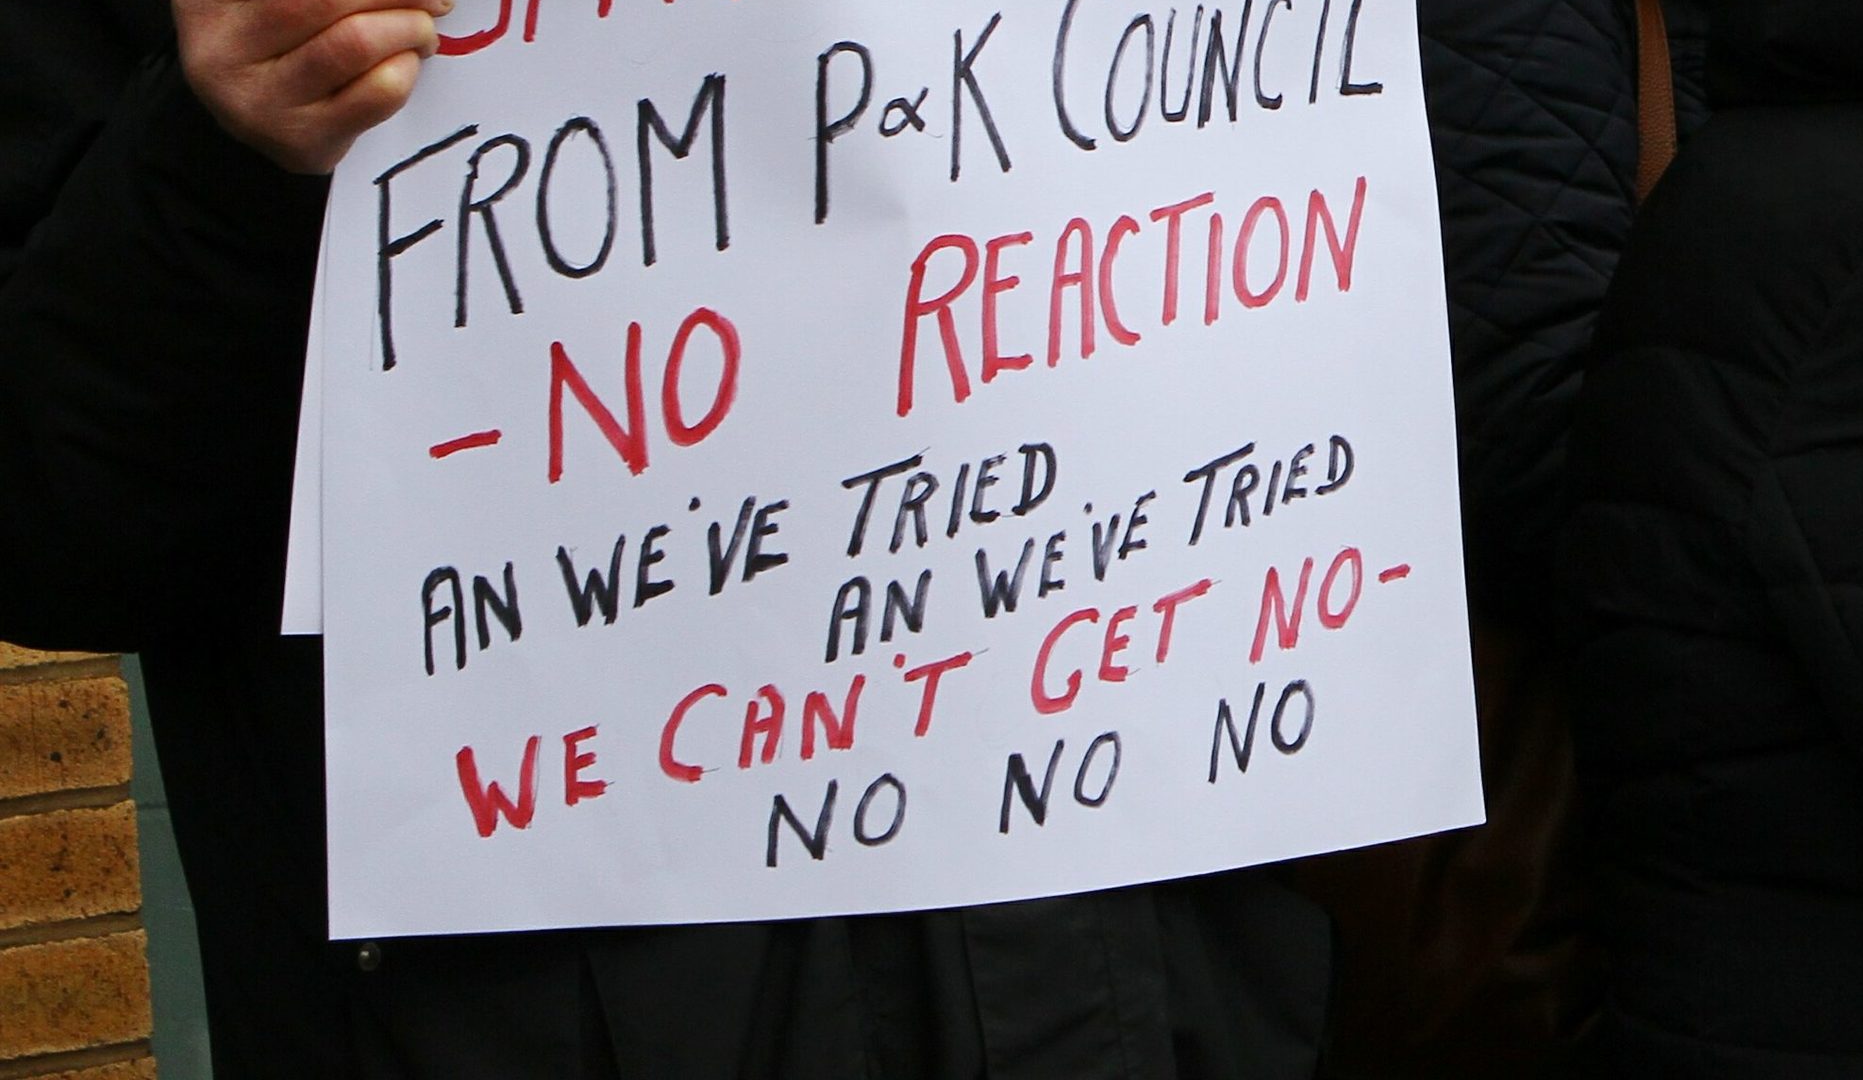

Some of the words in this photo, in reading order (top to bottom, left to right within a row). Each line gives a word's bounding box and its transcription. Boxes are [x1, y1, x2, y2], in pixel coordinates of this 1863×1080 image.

[371, 71, 731, 372] FROM
[547, 307, 742, 485] NO
[896, 175, 1368, 418] REACTION
[420, 560, 523, 677] AN
[554, 495, 790, 628] WE'VE
[840, 441, 1058, 559] TRIED
[824, 568, 933, 664] AN
[974, 488, 1157, 619] WE'VE
[1181, 434, 1355, 547] TRIED
[455, 724, 609, 838] WE
[658, 650, 974, 784] CAN'T
[1030, 578, 1213, 715] GET
[765, 772, 907, 868] NO
[998, 730, 1122, 835] NO
[1207, 678, 1315, 785] NO
